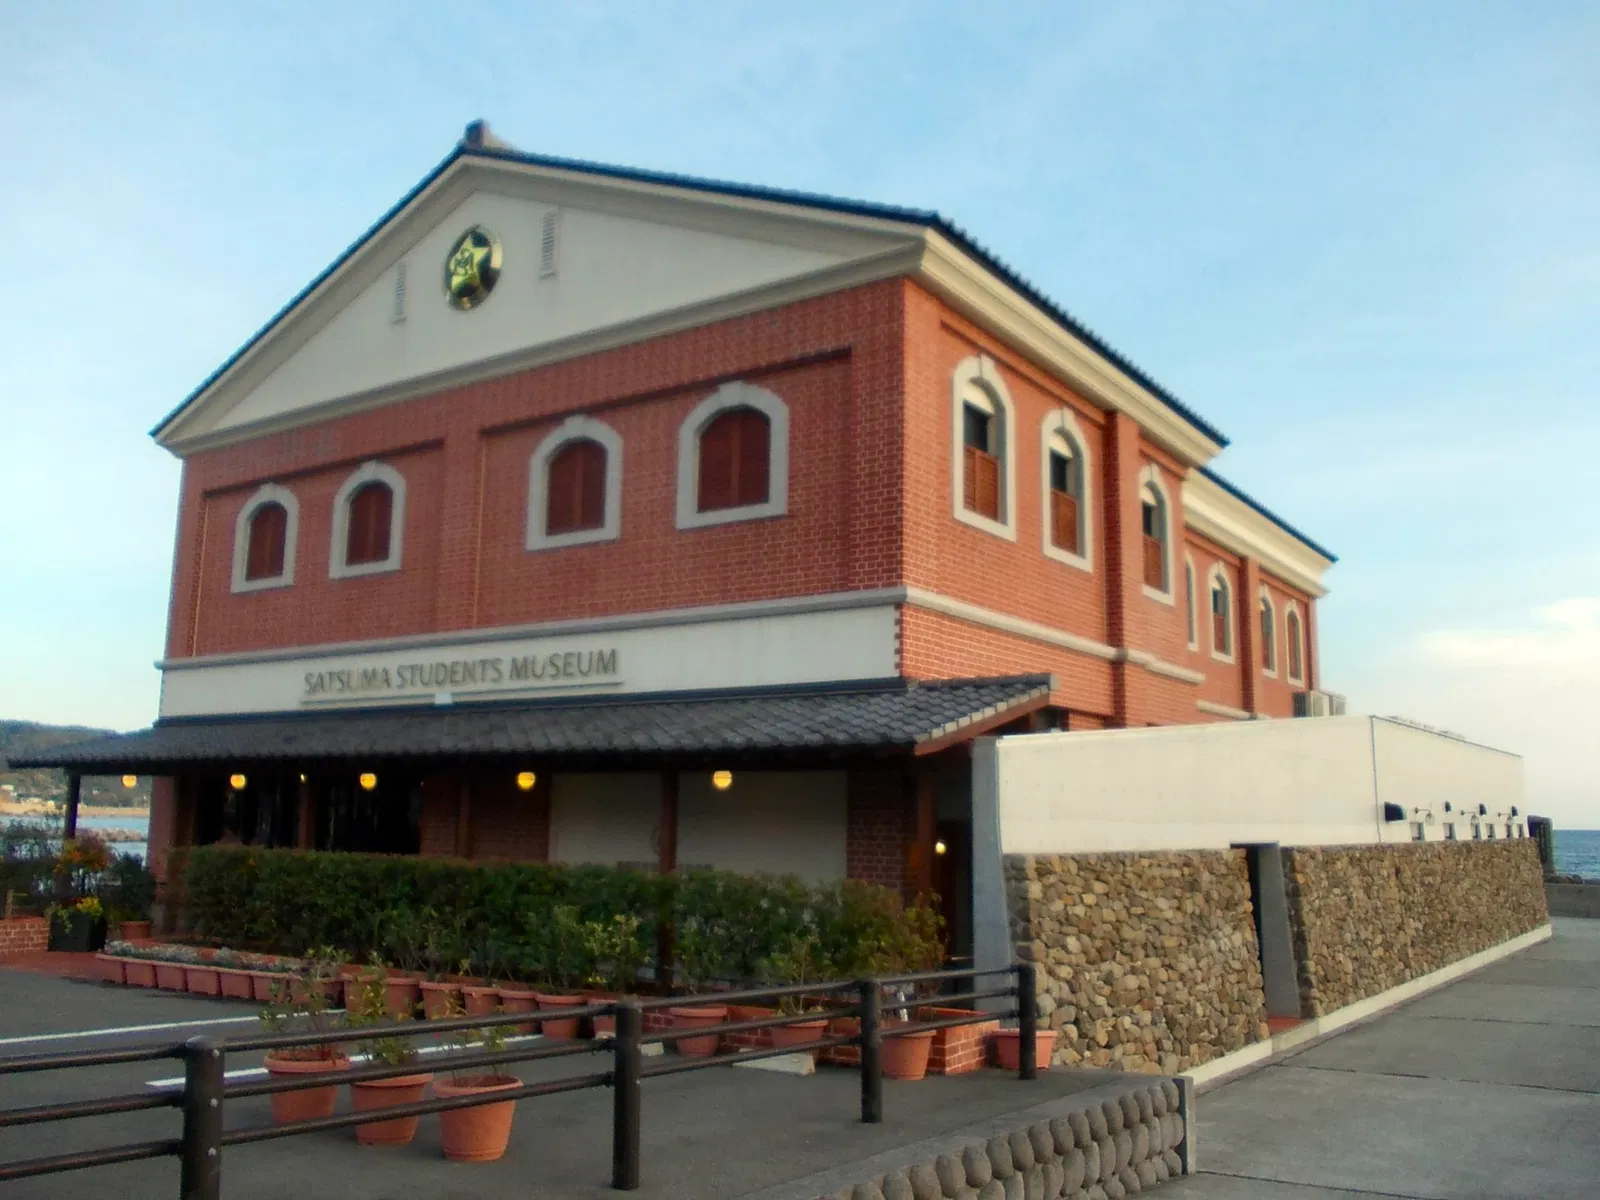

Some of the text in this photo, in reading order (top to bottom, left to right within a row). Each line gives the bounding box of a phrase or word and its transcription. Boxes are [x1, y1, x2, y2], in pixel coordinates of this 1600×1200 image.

[304, 649, 618, 694] SATSUMA STUDENTS MUSEUM
